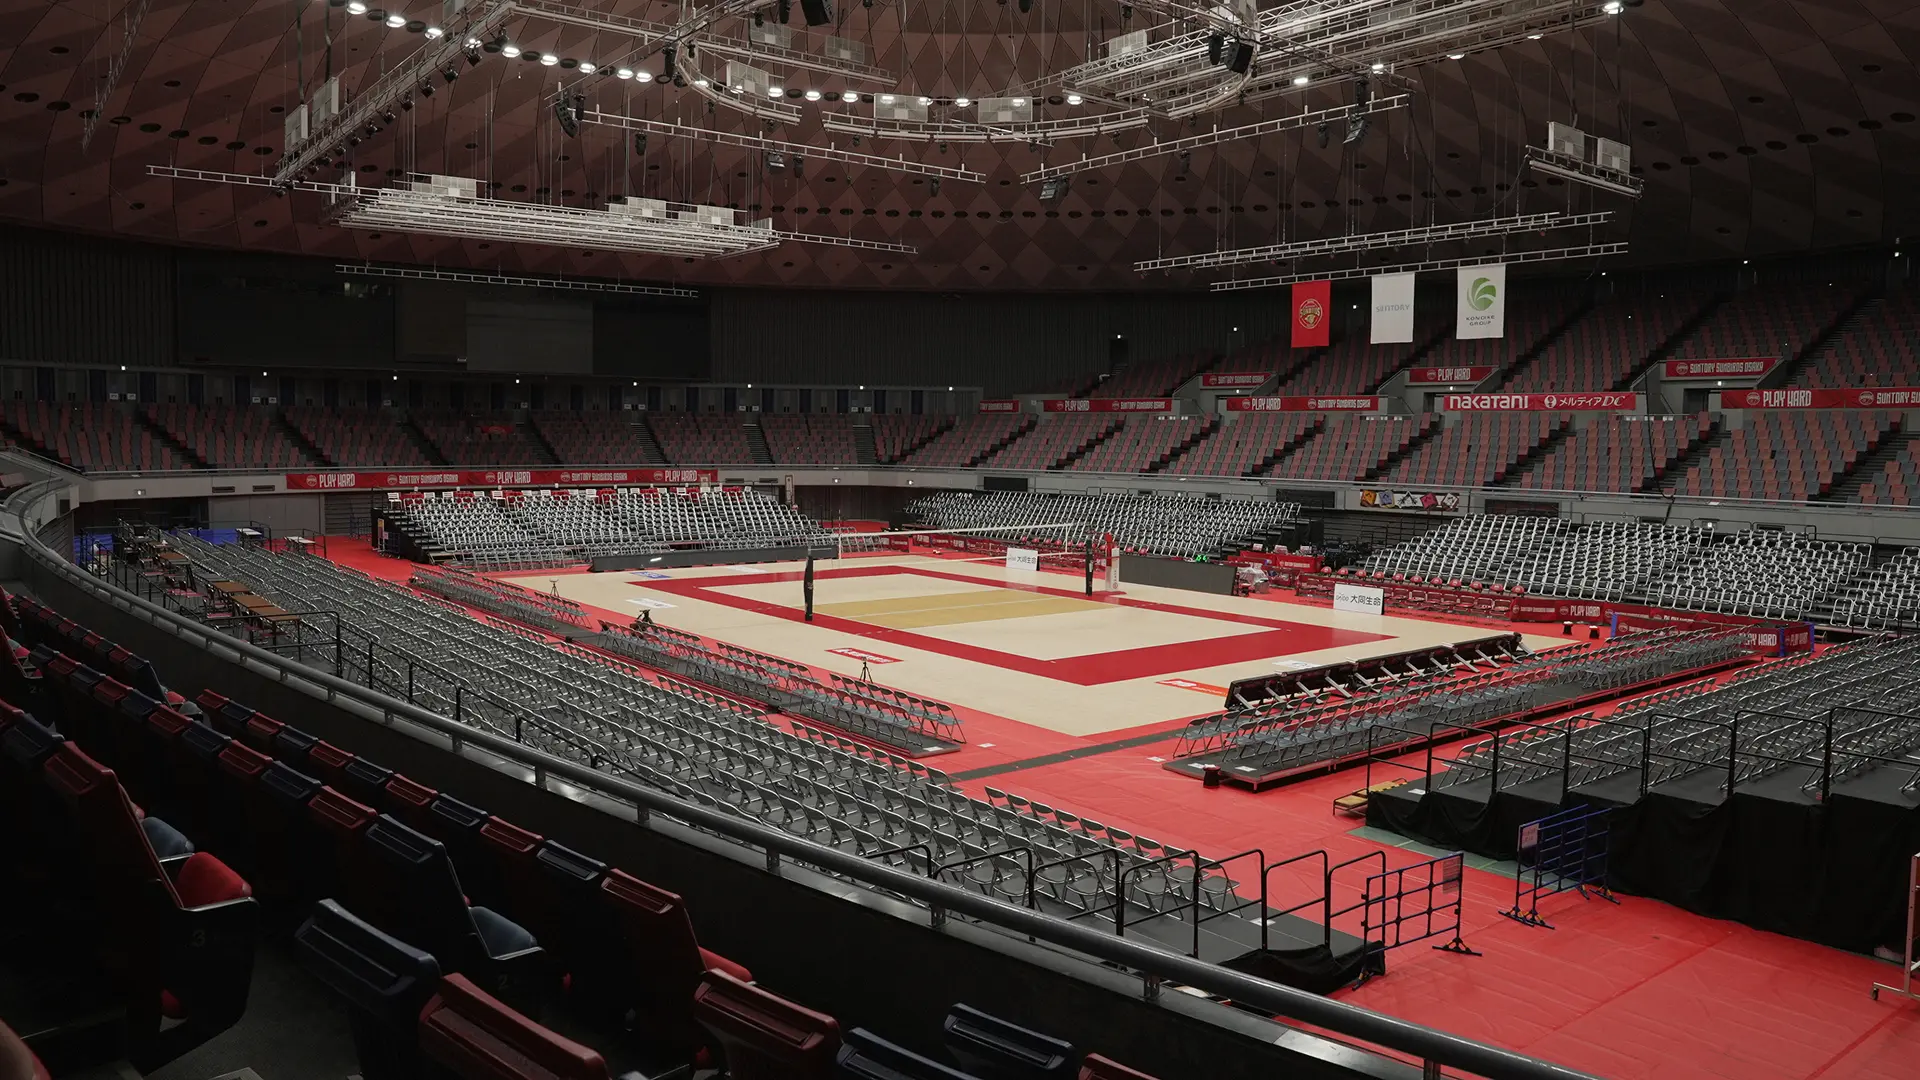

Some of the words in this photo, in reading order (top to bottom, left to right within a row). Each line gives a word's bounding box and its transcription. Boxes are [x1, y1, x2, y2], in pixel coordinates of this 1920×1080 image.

[1690, 363, 1714, 373] SUNTORY
[1716, 362, 1743, 372] SUNBIRDS
[1744, 361, 1764, 372] OSAKA
[1438, 368, 1453, 381] PLAY
[1454, 368, 1471, 381] HARD
[1252, 399, 1266, 410] PLAY
[1267, 398, 1281, 410] HARD
[1450, 395, 1529, 409] nakatani
[1763, 391, 1786, 407] PLAY
[1787, 390, 1812, 406] HARD
[1876, 392, 1910, 404] SUNTORY
[319, 474, 337, 488] PLAY
[337, 473, 355, 487] HARD
[497, 472, 514, 485] PLAY
[514, 471, 531, 484] HARD
[665, 470, 681, 482] PLAY
[682, 470, 698, 482] HARD
[1570, 605, 1585, 616] PLAY
[1586, 606, 1600, 617] HARD
[1758, 633, 1777, 646] HARD
